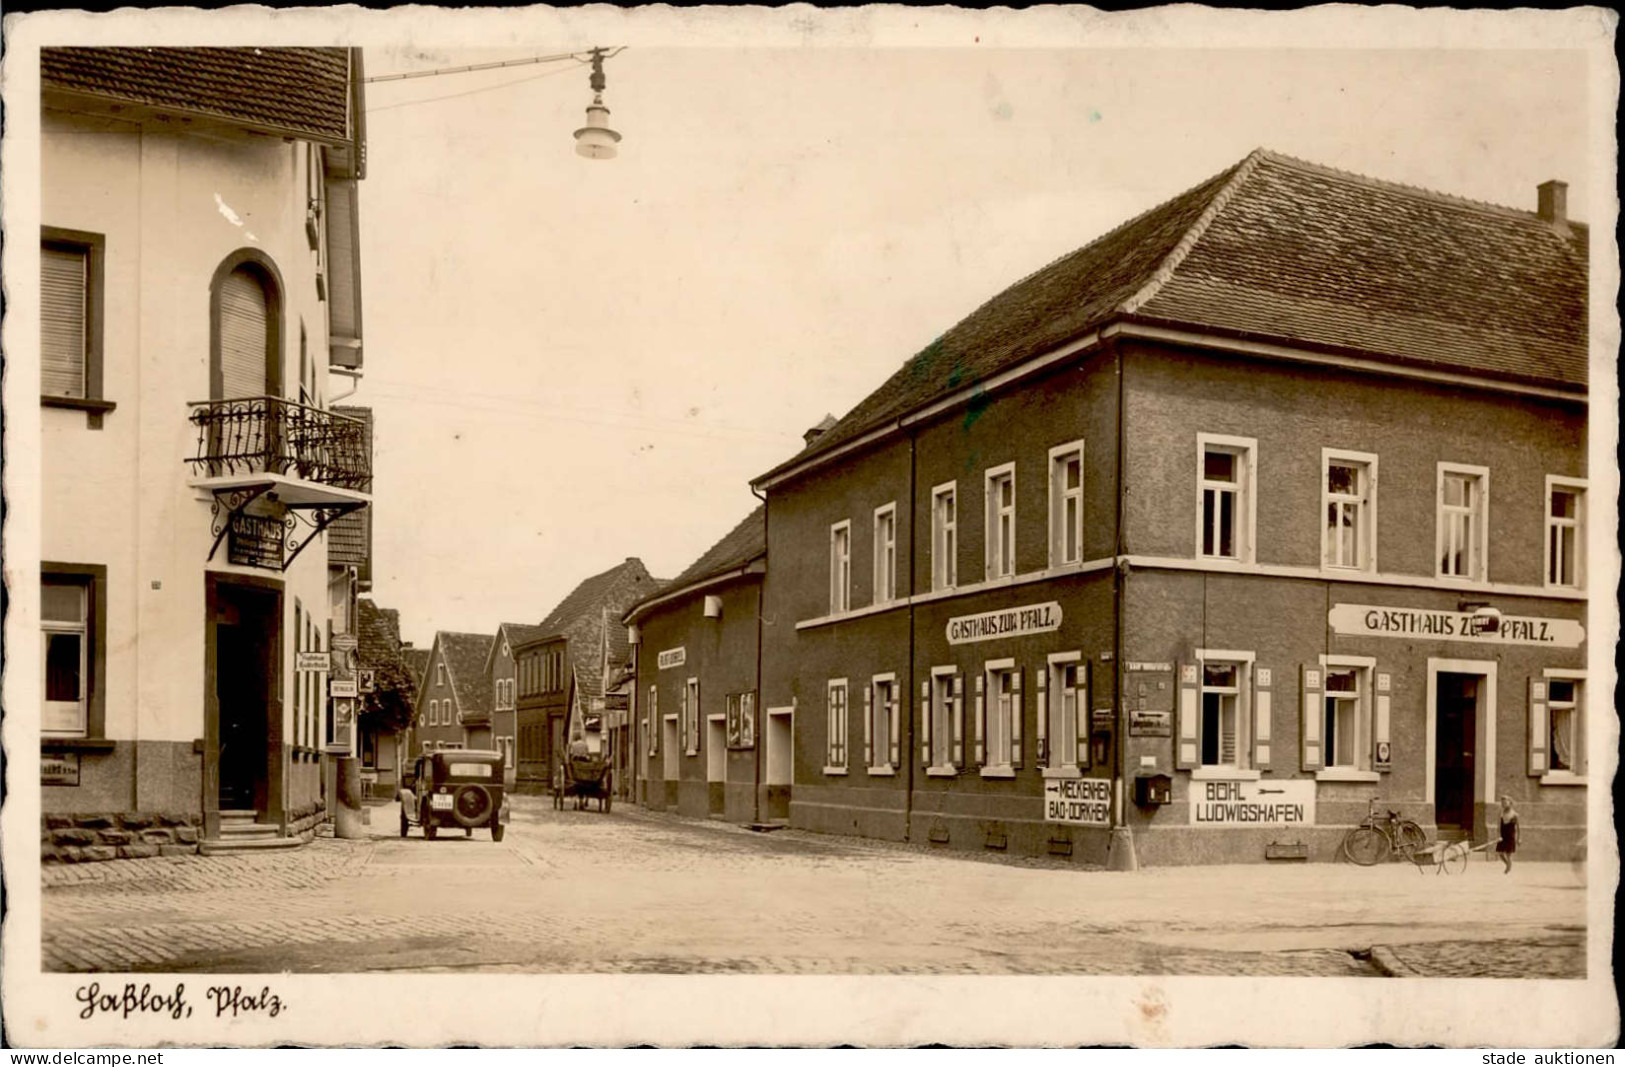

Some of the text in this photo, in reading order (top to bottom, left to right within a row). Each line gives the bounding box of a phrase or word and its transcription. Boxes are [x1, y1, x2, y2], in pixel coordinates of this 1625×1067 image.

[232, 516, 282, 540] GASTHAUS
[951, 606, 1055, 640] GASTHAUS ZUM PFALZ.
[1365, 610, 1454, 636] GASTHAUS
[1501, 619, 1554, 642] PFALZ.
[1196, 803, 1304, 822] LUDWIGSHAFEN
